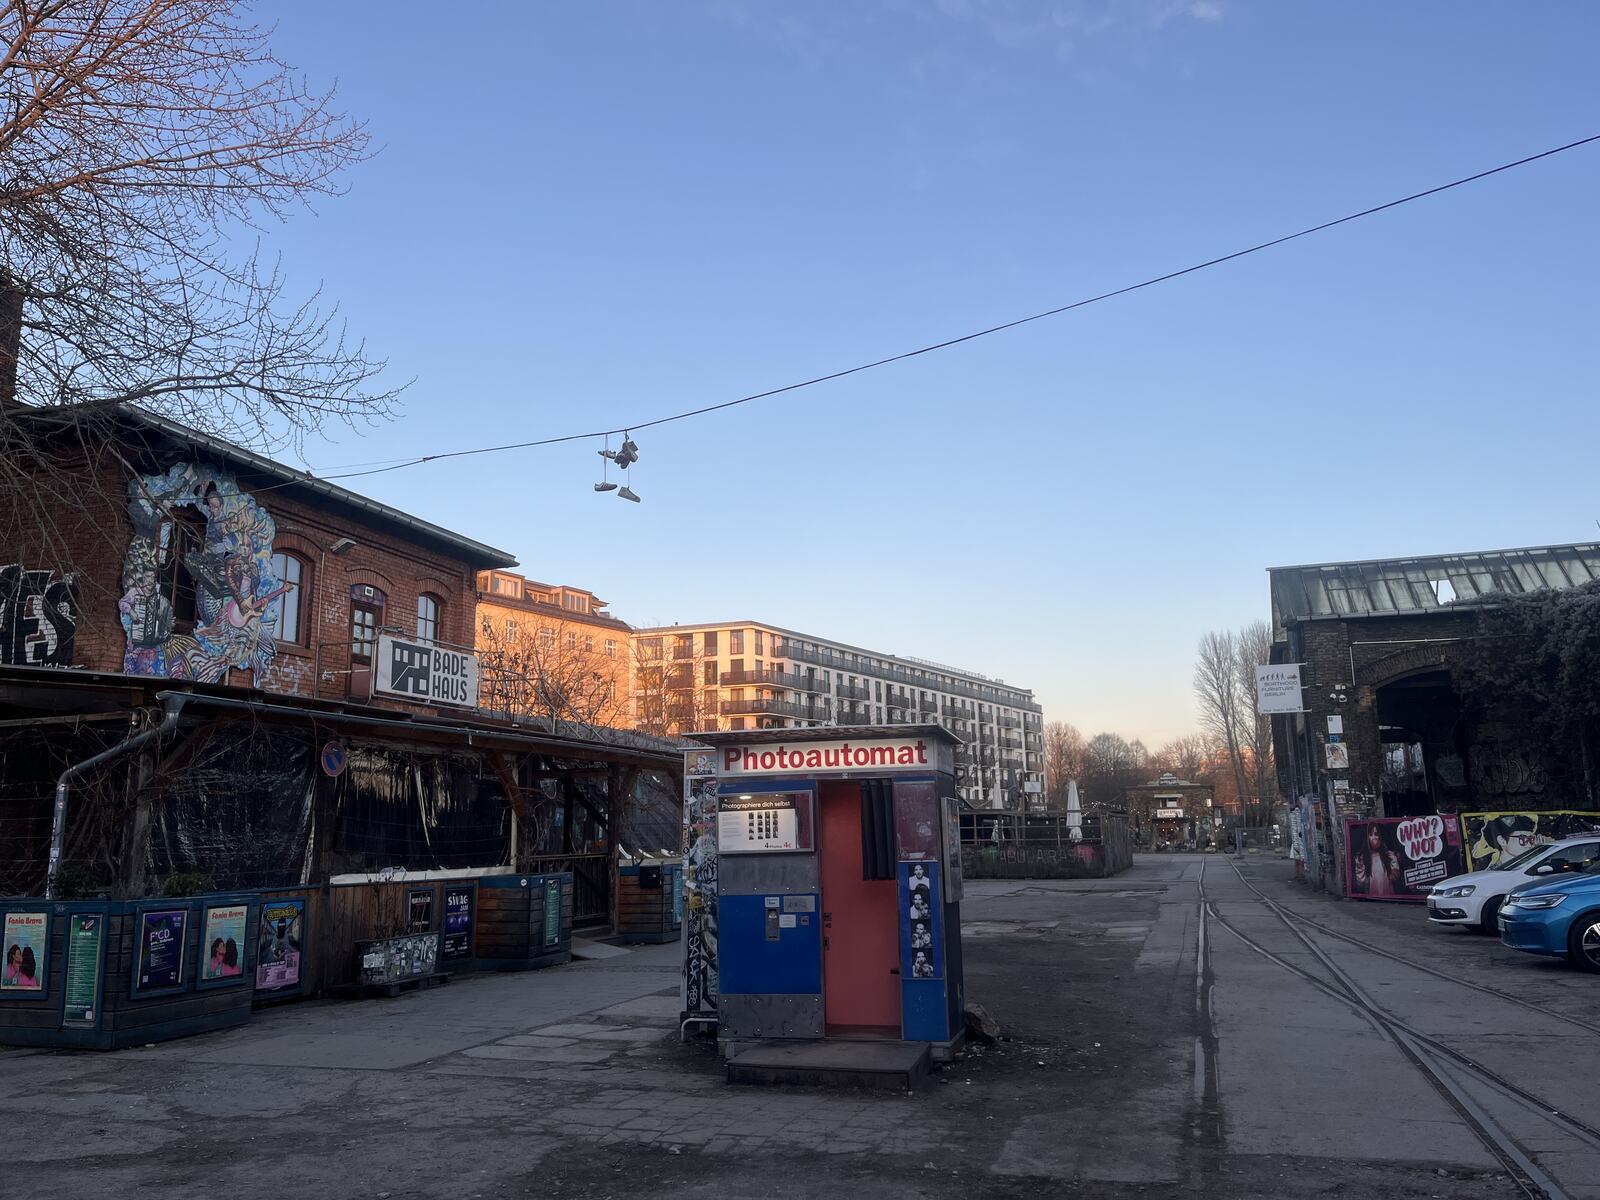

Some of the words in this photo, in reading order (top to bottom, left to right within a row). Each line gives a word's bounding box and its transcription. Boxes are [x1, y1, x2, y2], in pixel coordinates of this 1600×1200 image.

[433, 650, 469, 678] BADE
[432, 674, 468, 702] HAUS
[724, 740, 928, 771] Photoautomat
[721, 802, 761, 810] Photographiere
[1399, 818, 1438, 842] WHY?
[1410, 836, 1437, 858] NOT
